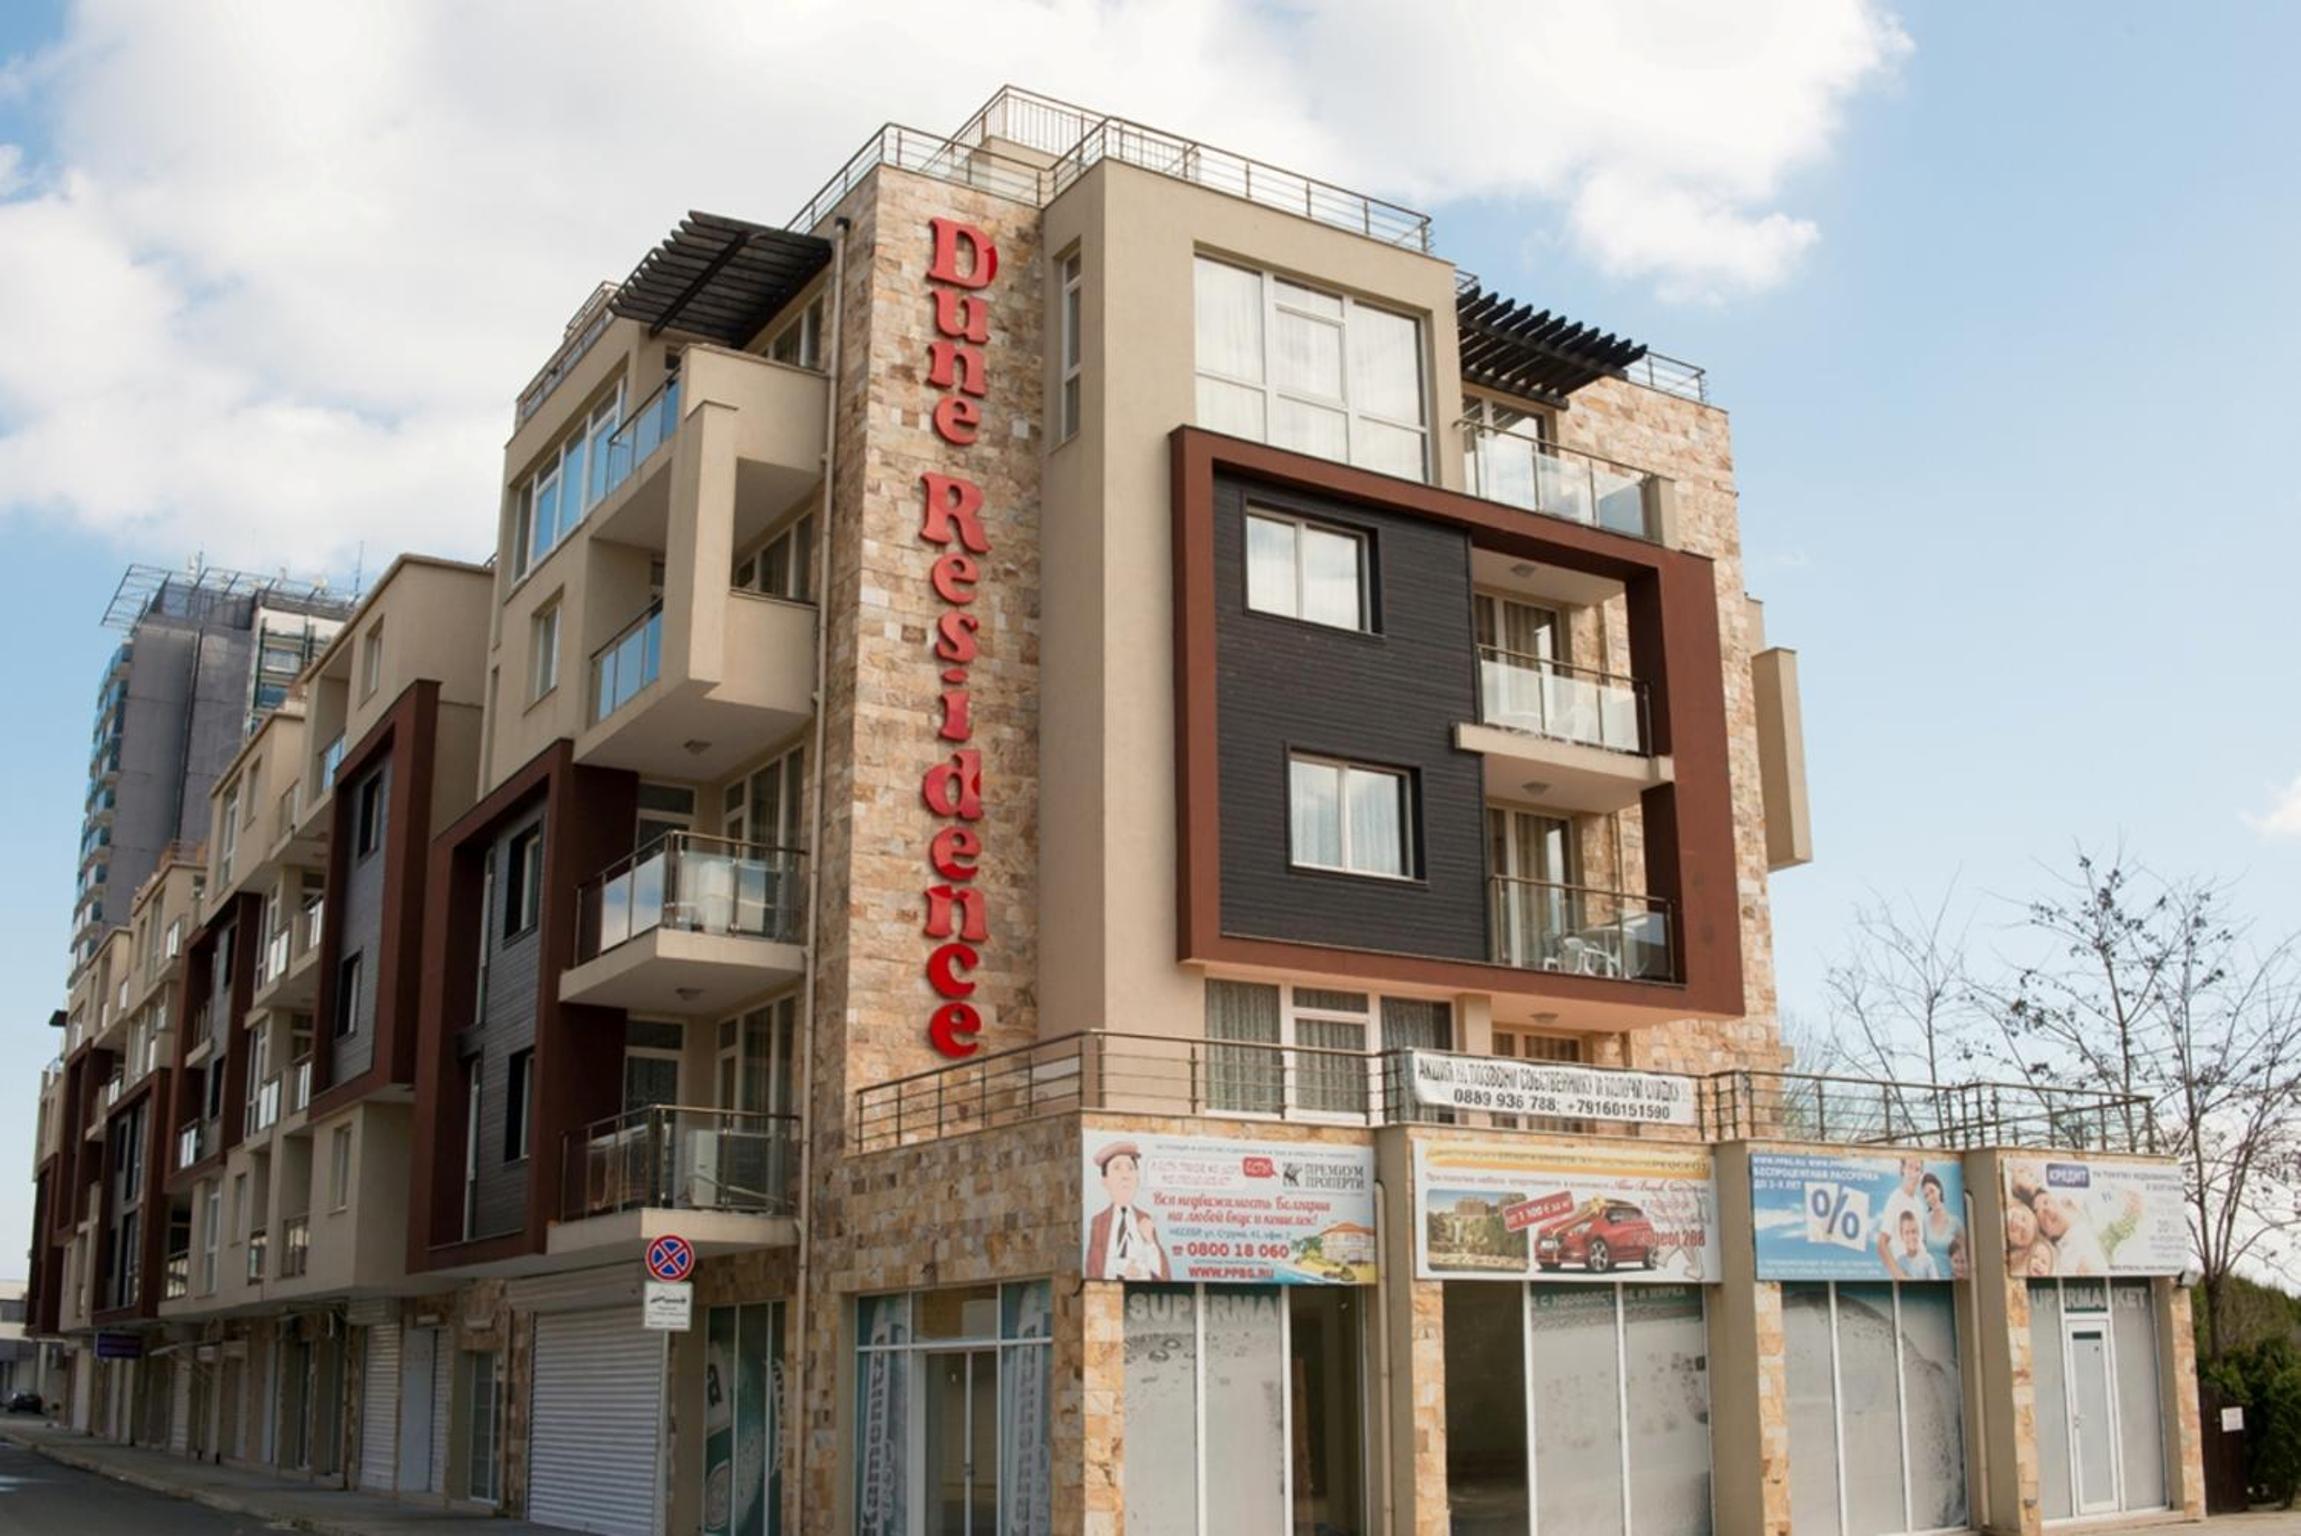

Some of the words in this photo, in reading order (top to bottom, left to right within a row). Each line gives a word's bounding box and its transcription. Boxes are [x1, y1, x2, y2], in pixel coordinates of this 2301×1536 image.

[926, 216, 998, 446] Dune
[919, 472, 992, 1060] Residence
[1454, 1088, 1492, 1106] 0889
[1305, 1162, 1365, 1178] ПРЕМИУМ
[1187, 1242, 1230, 1257] 0800
[1235, 1243, 1254, 1257] 18
[1259, 1243, 1289, 1259] 060
